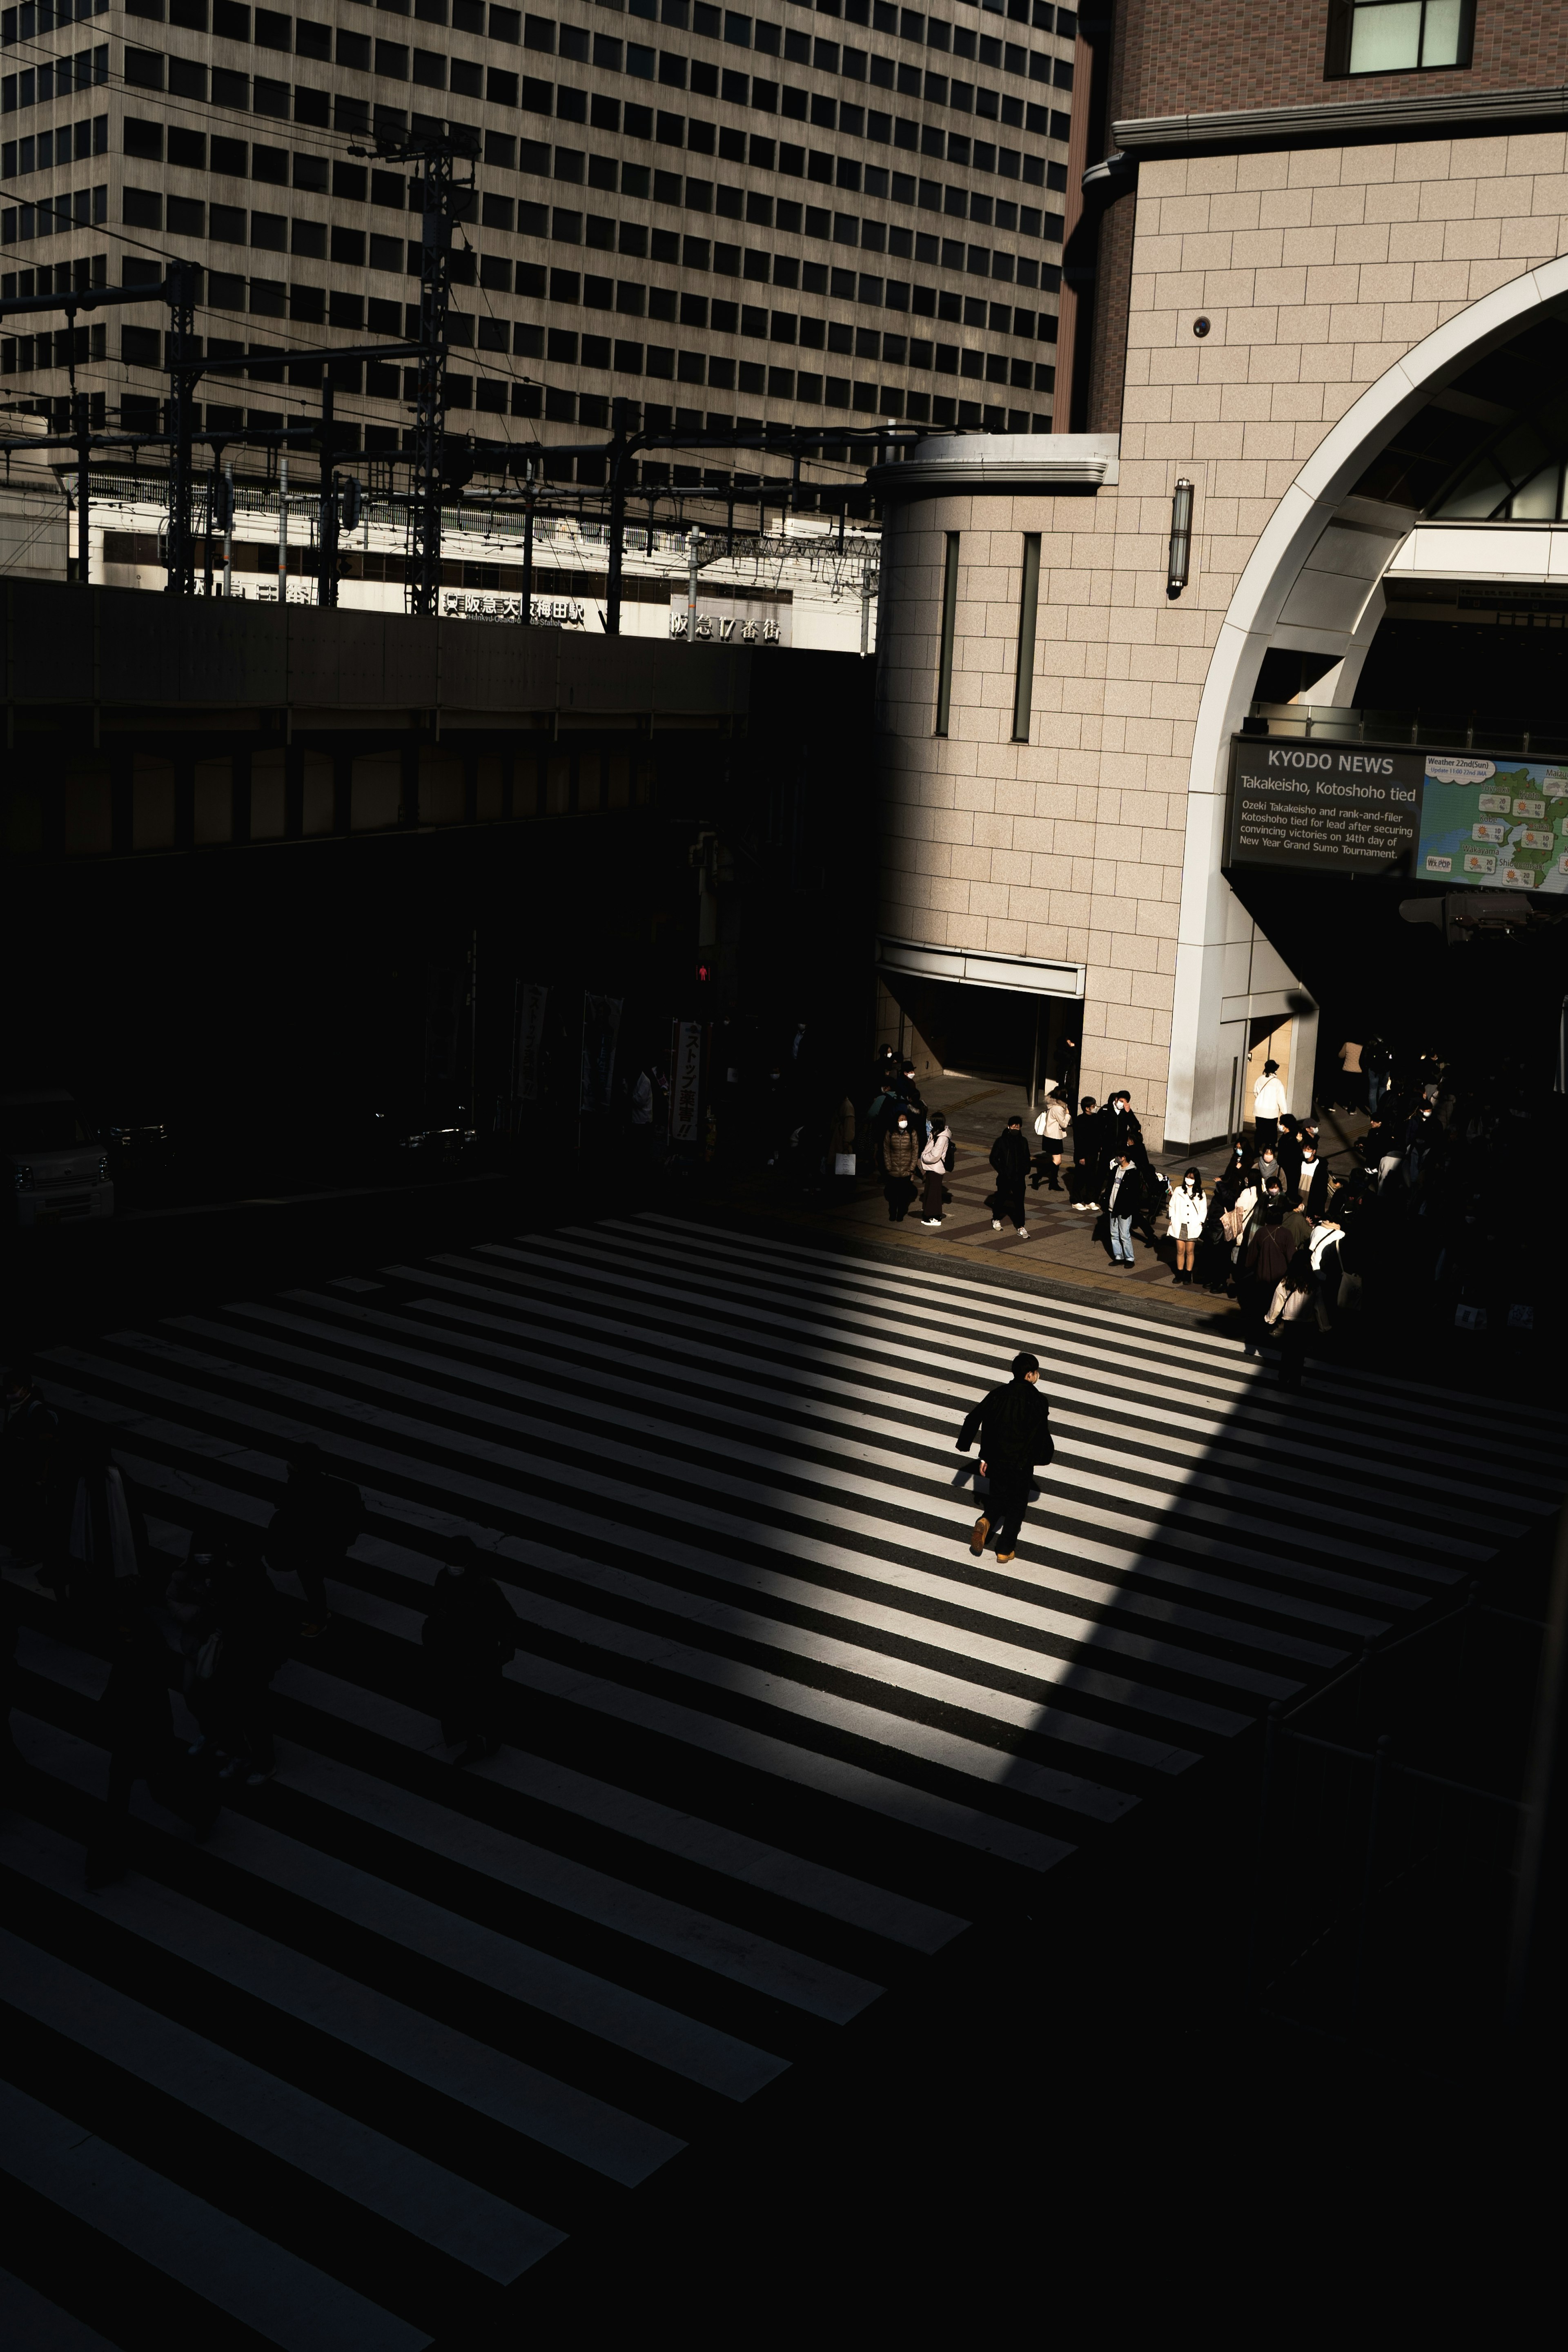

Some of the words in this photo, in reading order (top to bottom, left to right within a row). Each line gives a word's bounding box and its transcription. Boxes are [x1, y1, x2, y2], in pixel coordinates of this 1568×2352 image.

[1268, 750, 1332, 770] KYODO
[1339, 755, 1393, 775] NEWS
[1428, 757, 1454, 766] Weather
[1456, 760, 1489, 769] 22nd(Sun)
[1546, 768, 1568, 777] Maizu
[1241, 775, 1310, 795] Takakeisho,
[1316, 781, 1385, 799] Kotoshoho
[1390, 787, 1416, 802] tied
[1481, 784, 1510, 793] Toyooka
[1519, 791, 1540, 800] Kyoto
[1242, 800, 1267, 811] Ozeki
[1270, 802, 1316, 815] Takakeisho
[1319, 808, 1336, 817] and
[1339, 809, 1403, 822] rank-and-filer
[1480, 815, 1497, 823] Kobe
[1242, 812, 1287, 824] Kotoshoho
[1291, 816, 1307, 826] tied
[1311, 818, 1324, 827] for
[1326, 819, 1345, 829] lead
[1348, 822, 1372, 831] after
[1374, 825, 1413, 838] securing
[1528, 822, 1549, 831] Osaka
[1240, 825, 1286, 838] convincing
[1289, 829, 1327, 840] victories
[1345, 833, 1365, 843] 14th
[1368, 835, 1385, 847] day
[1387, 837, 1398, 846] of
[1240, 835, 1259, 845] New
[1262, 837, 1281, 847] Year
[1283, 840, 1310, 850] Grand
[1313, 842, 1339, 853] Sumo
[1341, 845, 1398, 859] Tournament.
[1463, 845, 1499, 855] Wakayama
[1499, 859, 1545, 870] Shionomisaki
